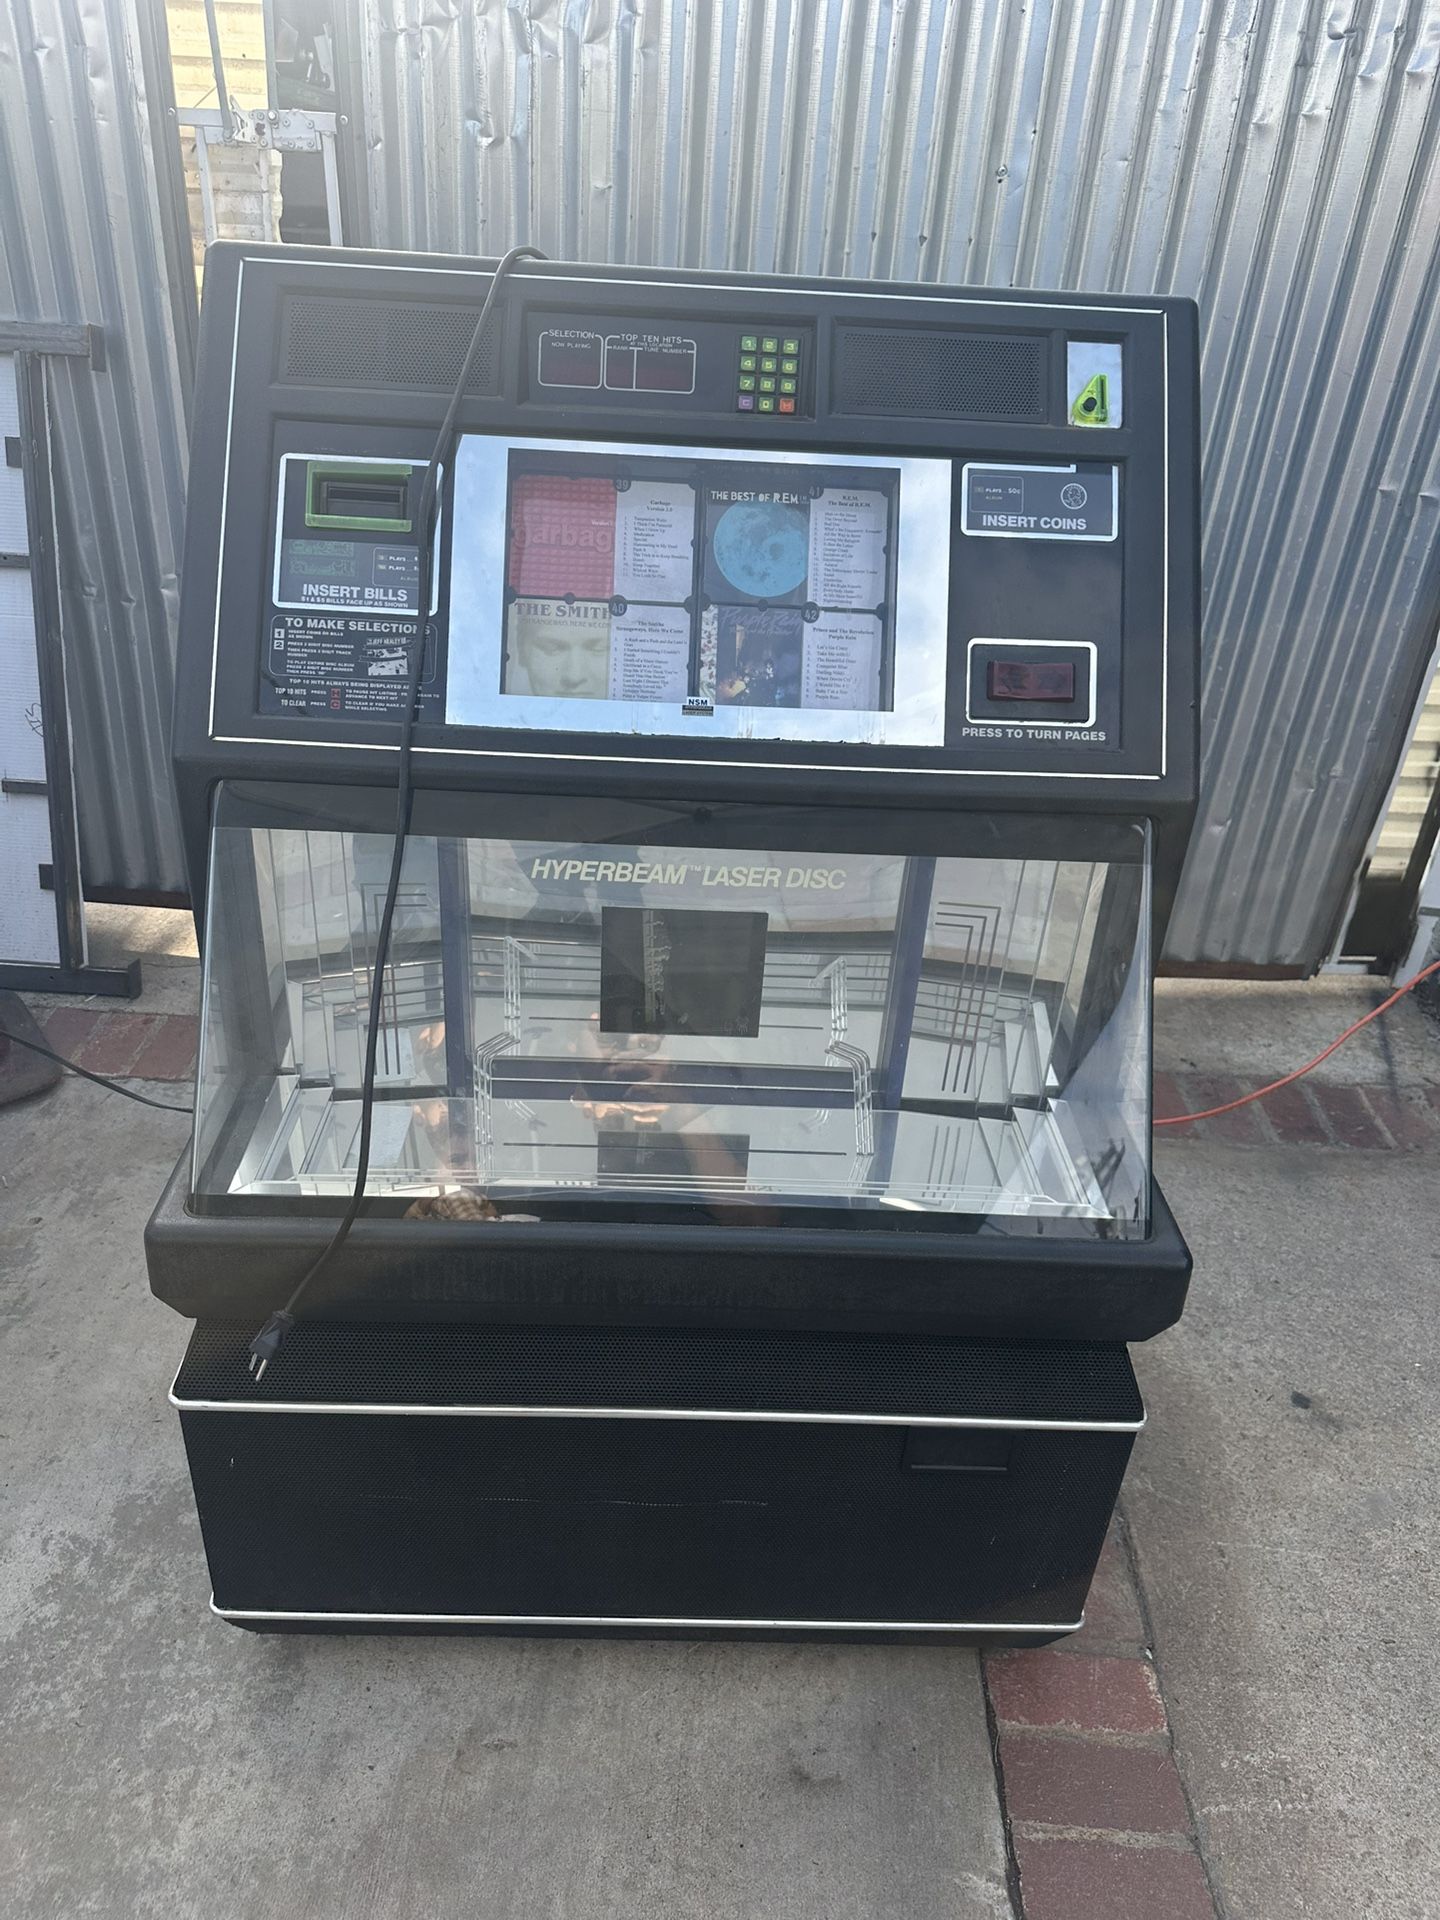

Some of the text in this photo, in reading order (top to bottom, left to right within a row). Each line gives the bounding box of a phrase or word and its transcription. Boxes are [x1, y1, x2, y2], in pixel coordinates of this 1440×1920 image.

[549, 330, 594, 339] SELECTION
[616, 480, 628, 490] 39
[711, 491, 728, 500] THE
[731, 491, 755, 501] BEST
[759, 493, 770, 502] OF
[983, 515, 1087, 530] INSERT COINS
[303, 584, 407, 601] INSERT BILLS
[514, 603, 551, 616] THE
[613, 603, 624, 613] 40
[804, 610, 817, 620] 42
[285, 617, 303, 627] TO
[307, 619, 345, 630] MAKE
[962, 728, 1106, 741] PRESS TO TURN PAGES
[702, 865, 782, 888] LASER
[786, 867, 847, 890] DISC
